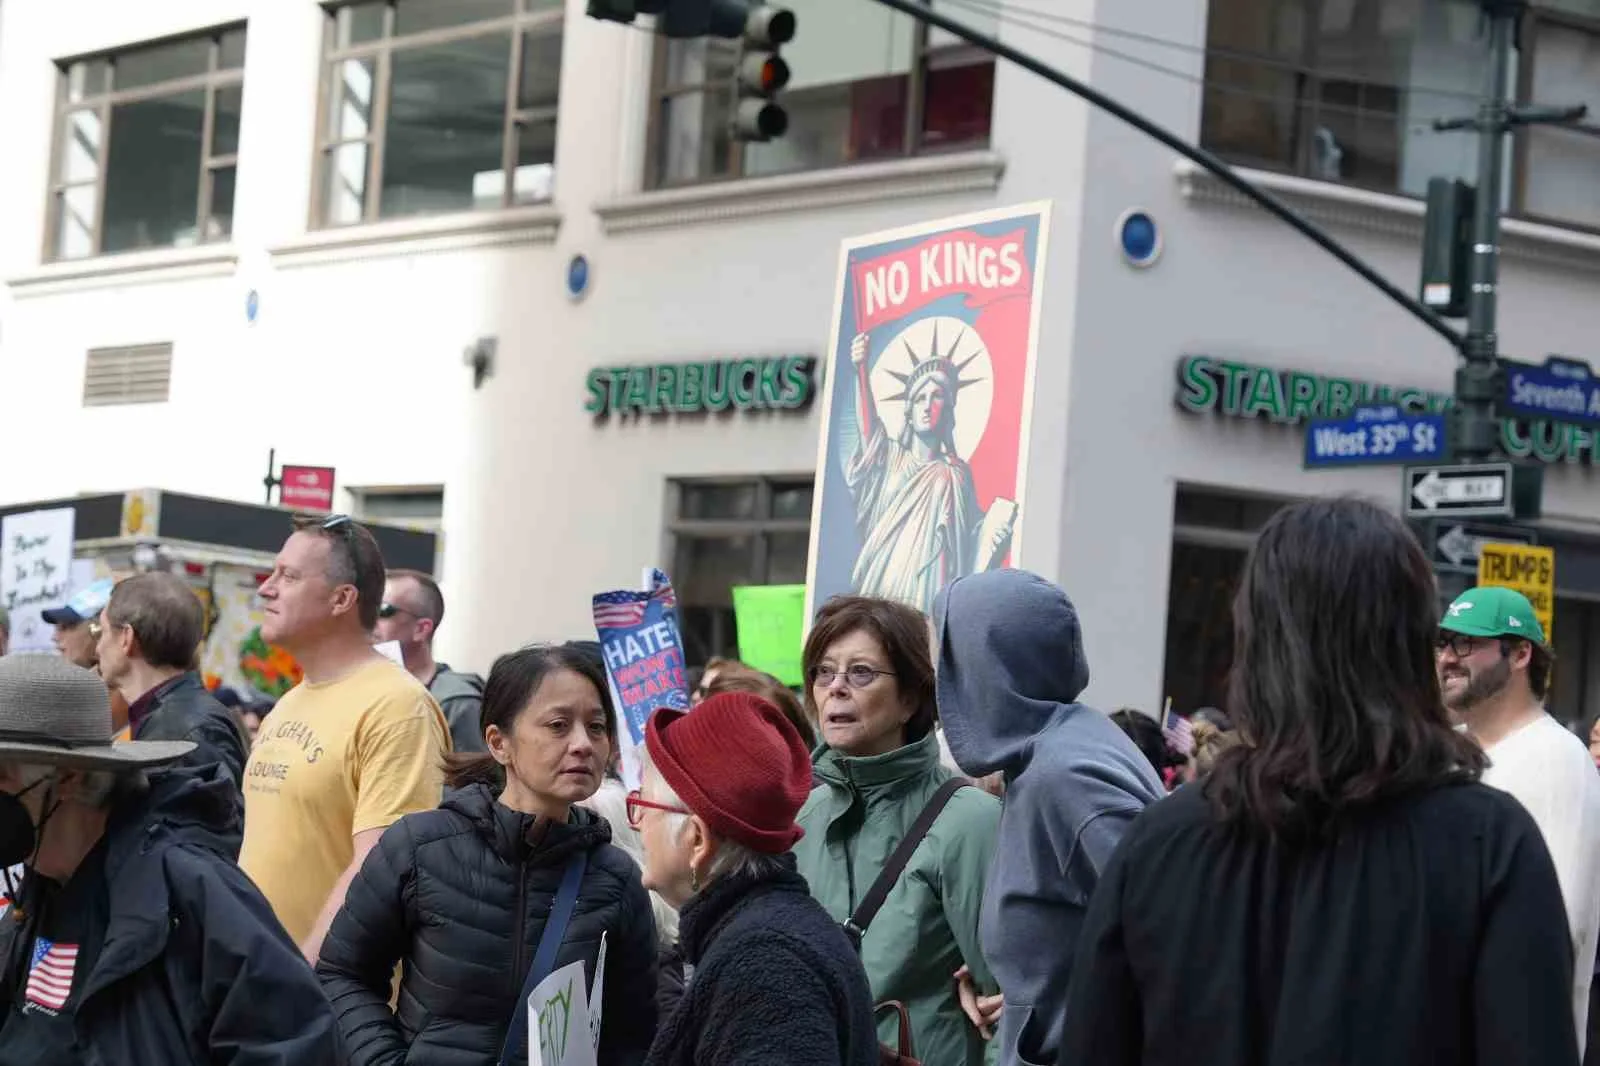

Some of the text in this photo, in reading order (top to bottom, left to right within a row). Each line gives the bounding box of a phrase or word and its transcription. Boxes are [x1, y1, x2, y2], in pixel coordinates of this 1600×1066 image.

[865, 240, 1022, 316] NO KINGS
[585, 354, 809, 416] STARBUCKS
[1511, 373, 1586, 414] Seventh
[1314, 420, 1437, 456] West 35th St
[1482, 551, 1537, 585] TRUMP
[603, 620, 675, 670] HATE
[620, 667, 688, 707] MAKE
[248, 760, 290, 781] LOUNGE
